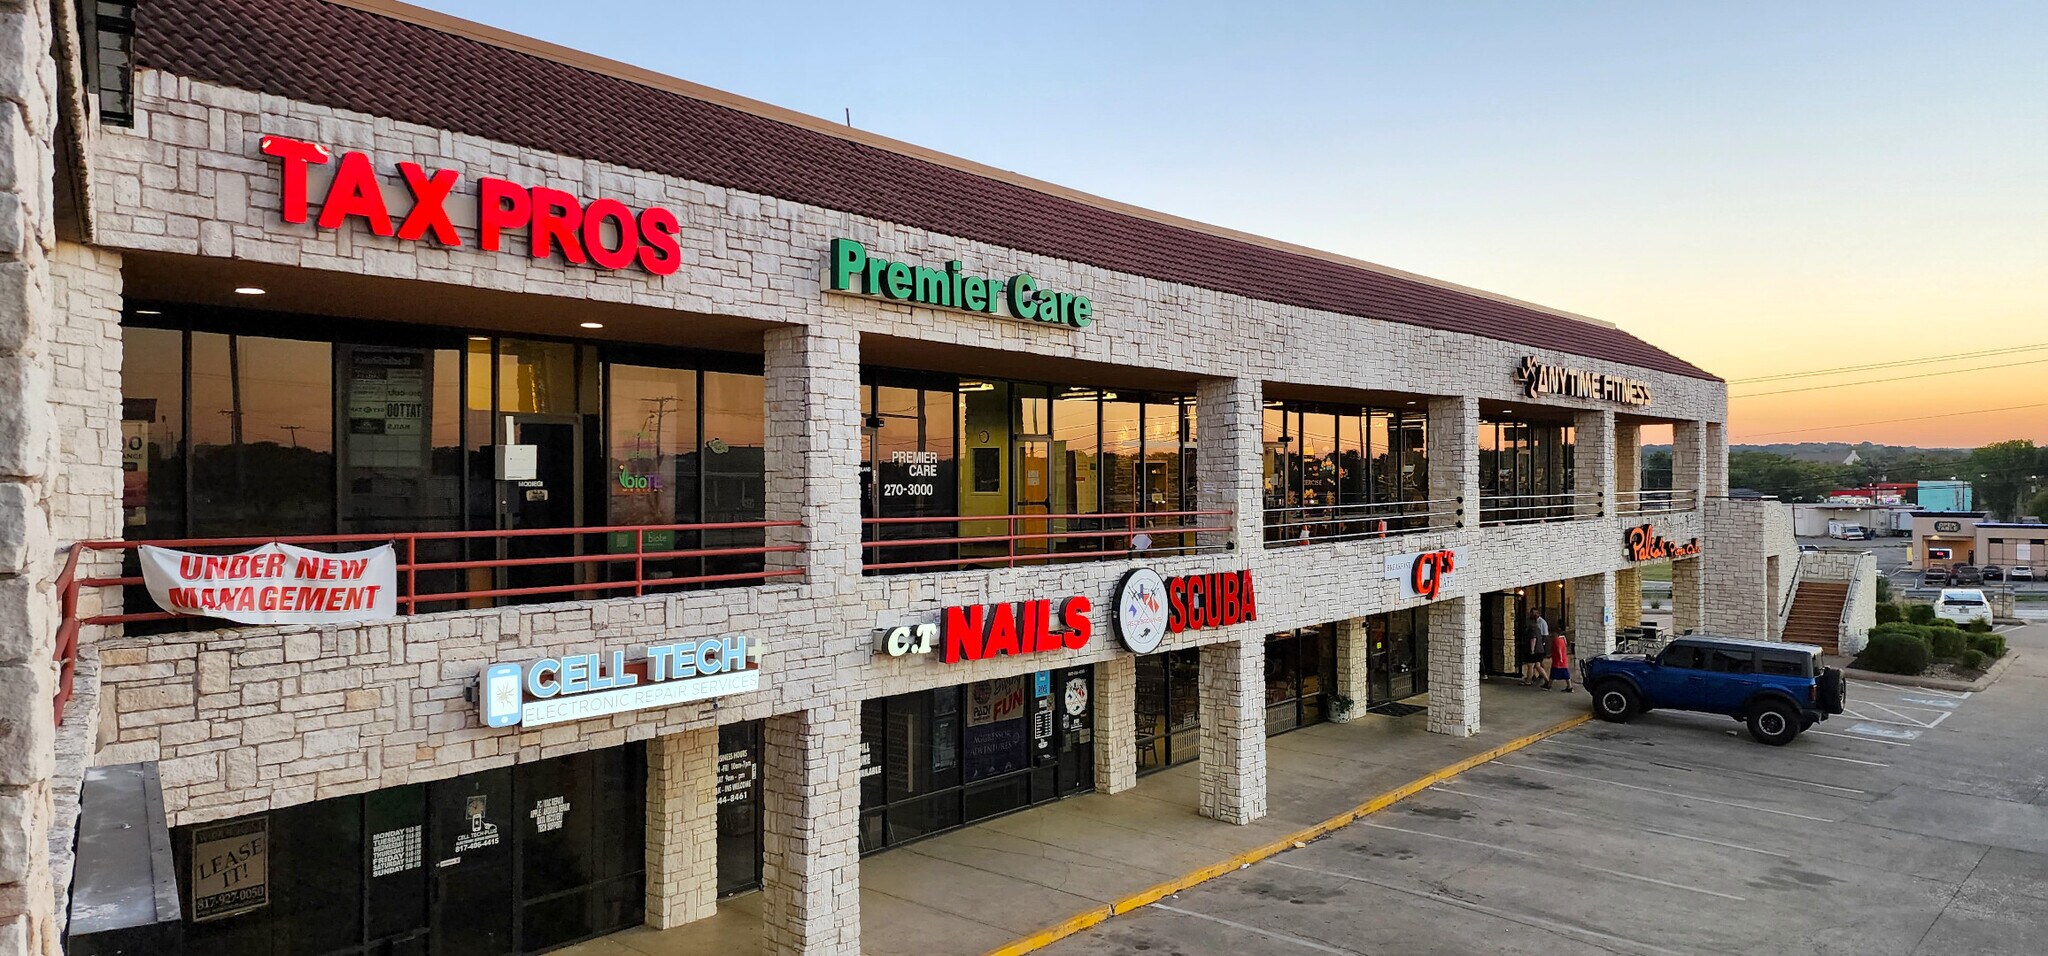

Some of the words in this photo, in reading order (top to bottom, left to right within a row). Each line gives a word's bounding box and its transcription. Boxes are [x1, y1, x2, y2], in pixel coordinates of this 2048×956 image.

[259, 135, 461, 246] TAX
[477, 176, 682, 276] PROS
[830, 238, 1006, 313] Premier
[1007, 272, 1093, 328] Care
[1537, 364, 1601, 399] ANYTIME
[1603, 374, 1652, 406] FITNESS
[891, 450, 938, 464] PREMIER
[908, 464, 938, 477] CARE
[884, 483, 933, 496] 270-3000
[179, 553, 287, 581] UNDER
[294, 556, 369, 580] NEW
[168, 584, 381, 612] MANAGEMENT
[1166, 568, 1258, 633] SCUBA
[940, 595, 1092, 664] NAILS
[527, 650, 639, 699] CELL
[524, 692, 631, 723] ELECTRONIC
[632, 684, 687, 706] REPAIR
[692, 673, 758, 697] SERVICES
[993, 687, 1023, 721] FUN
[372, 828, 405, 840] MONDAY
[372, 834, 405, 847] TUESDAY
[199, 838, 264, 880] LEASE
[372, 846, 405, 859] THURSDAY
[372, 852, 405, 865] FRIDAY
[372, 858, 405, 871] SATURDAY
[222, 863, 249, 888] IT!
[372, 864, 405, 878] SUNDAY
